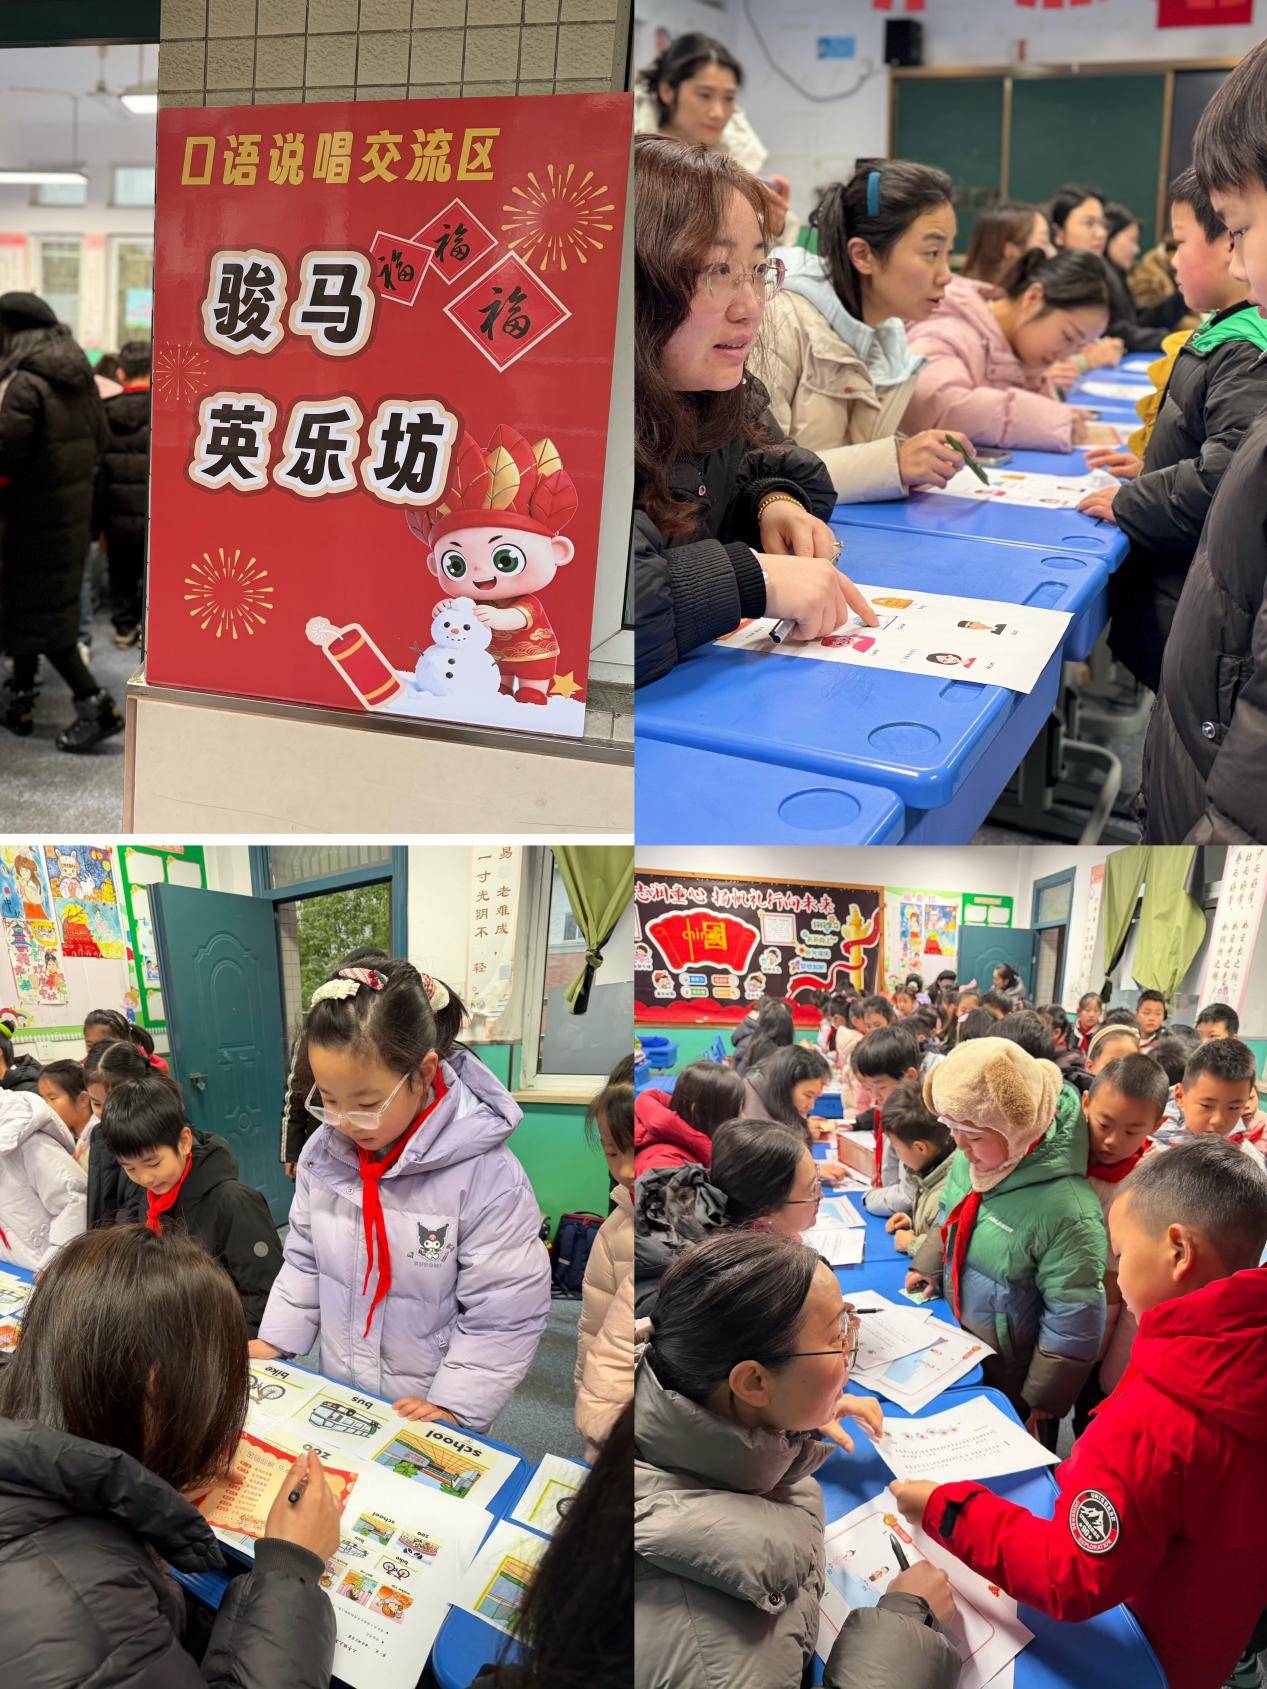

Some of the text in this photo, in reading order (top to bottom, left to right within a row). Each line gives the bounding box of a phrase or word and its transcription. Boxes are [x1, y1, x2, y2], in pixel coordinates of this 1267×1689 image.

[181, 127, 501, 187] 口语说唱交流区
[433, 223, 472, 265] 福
[376, 248, 416, 292] 福
[209, 257, 369, 349] 骏马
[476, 285, 534, 342] 福
[198, 399, 450, 497] 英乐坊
[264, 1365, 290, 1380] bike
[351, 1395, 374, 1409] bus
[425, 1430, 483, 1457] school
[371, 1511, 396, 1525] school
[354, 1535, 366, 1544] bus
[416, 1530, 430, 1539] zoo
[395, 1555, 409, 1566] bike
